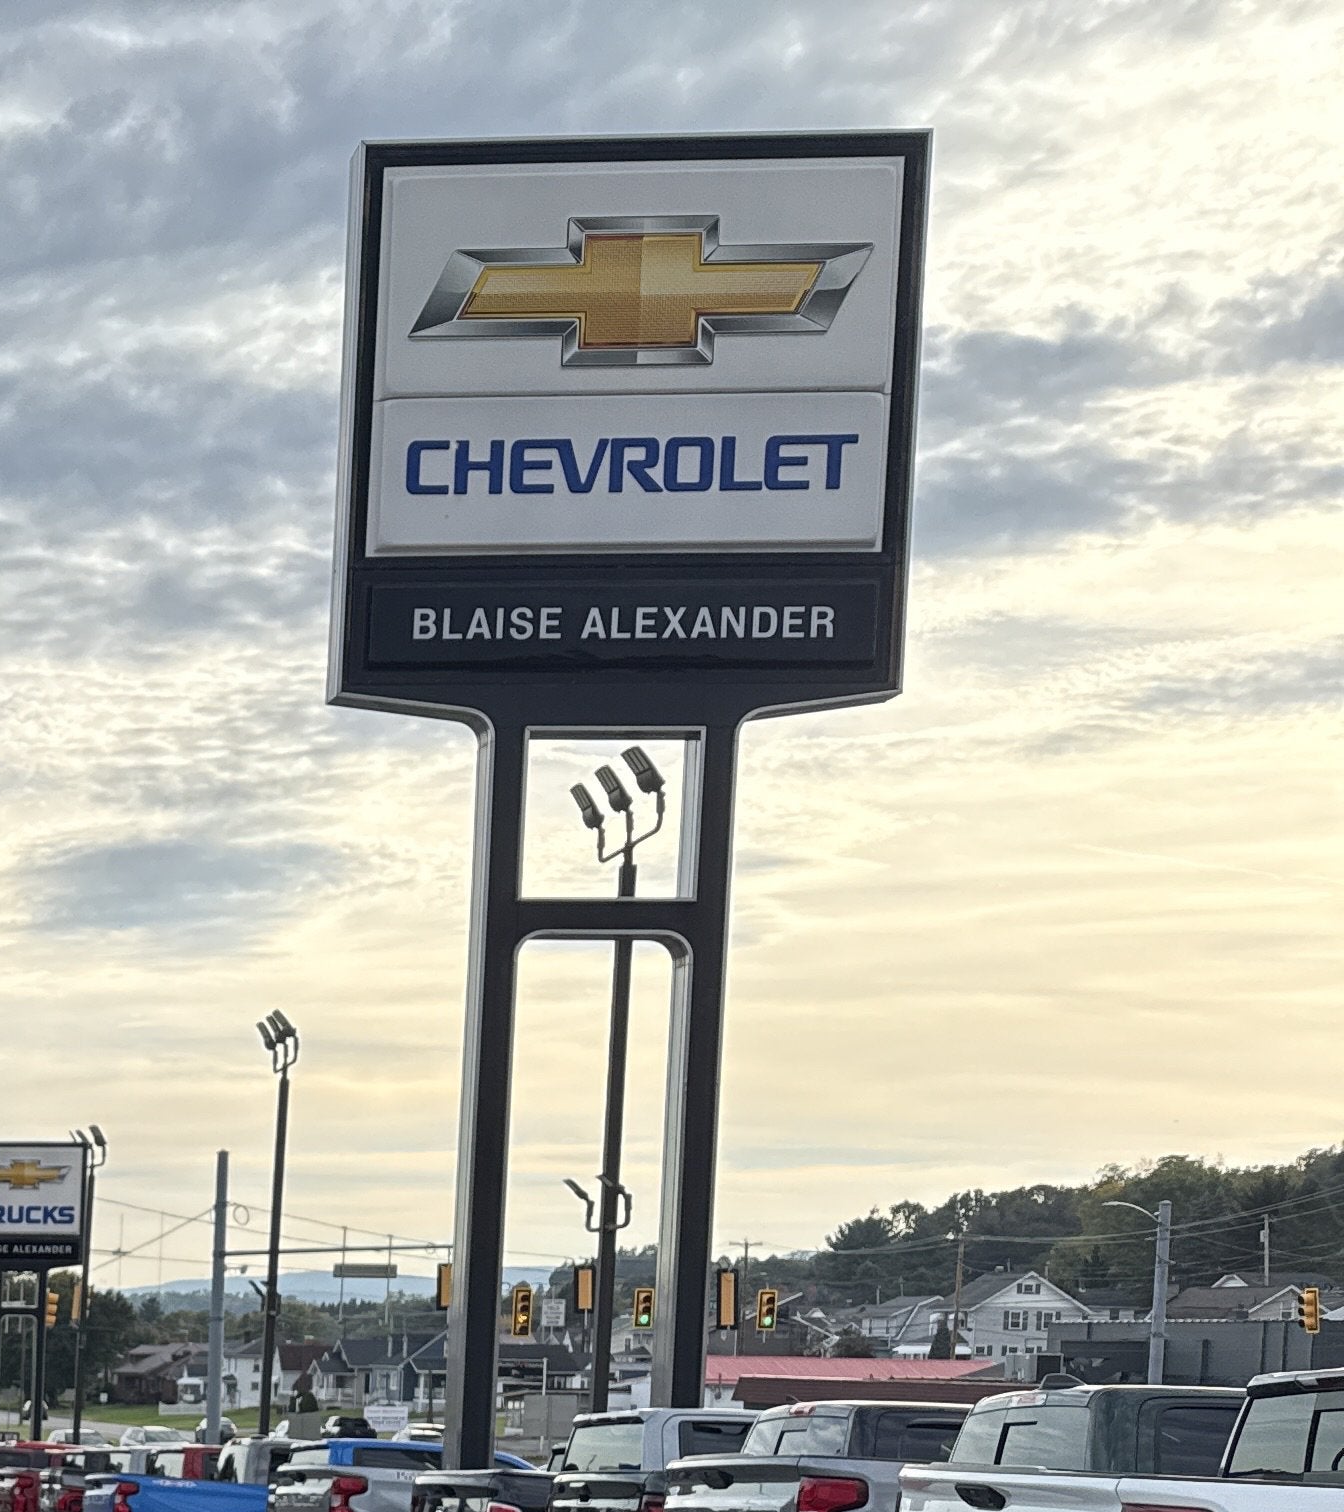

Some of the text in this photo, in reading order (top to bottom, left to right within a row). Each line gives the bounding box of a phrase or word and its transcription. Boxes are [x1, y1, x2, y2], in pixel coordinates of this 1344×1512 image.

[404, 433, 859, 496] CHEVROLET
[411, 605, 836, 641] BLAISE ALEXANDER
[11, 1244, 73, 1254] ALEXANDER
